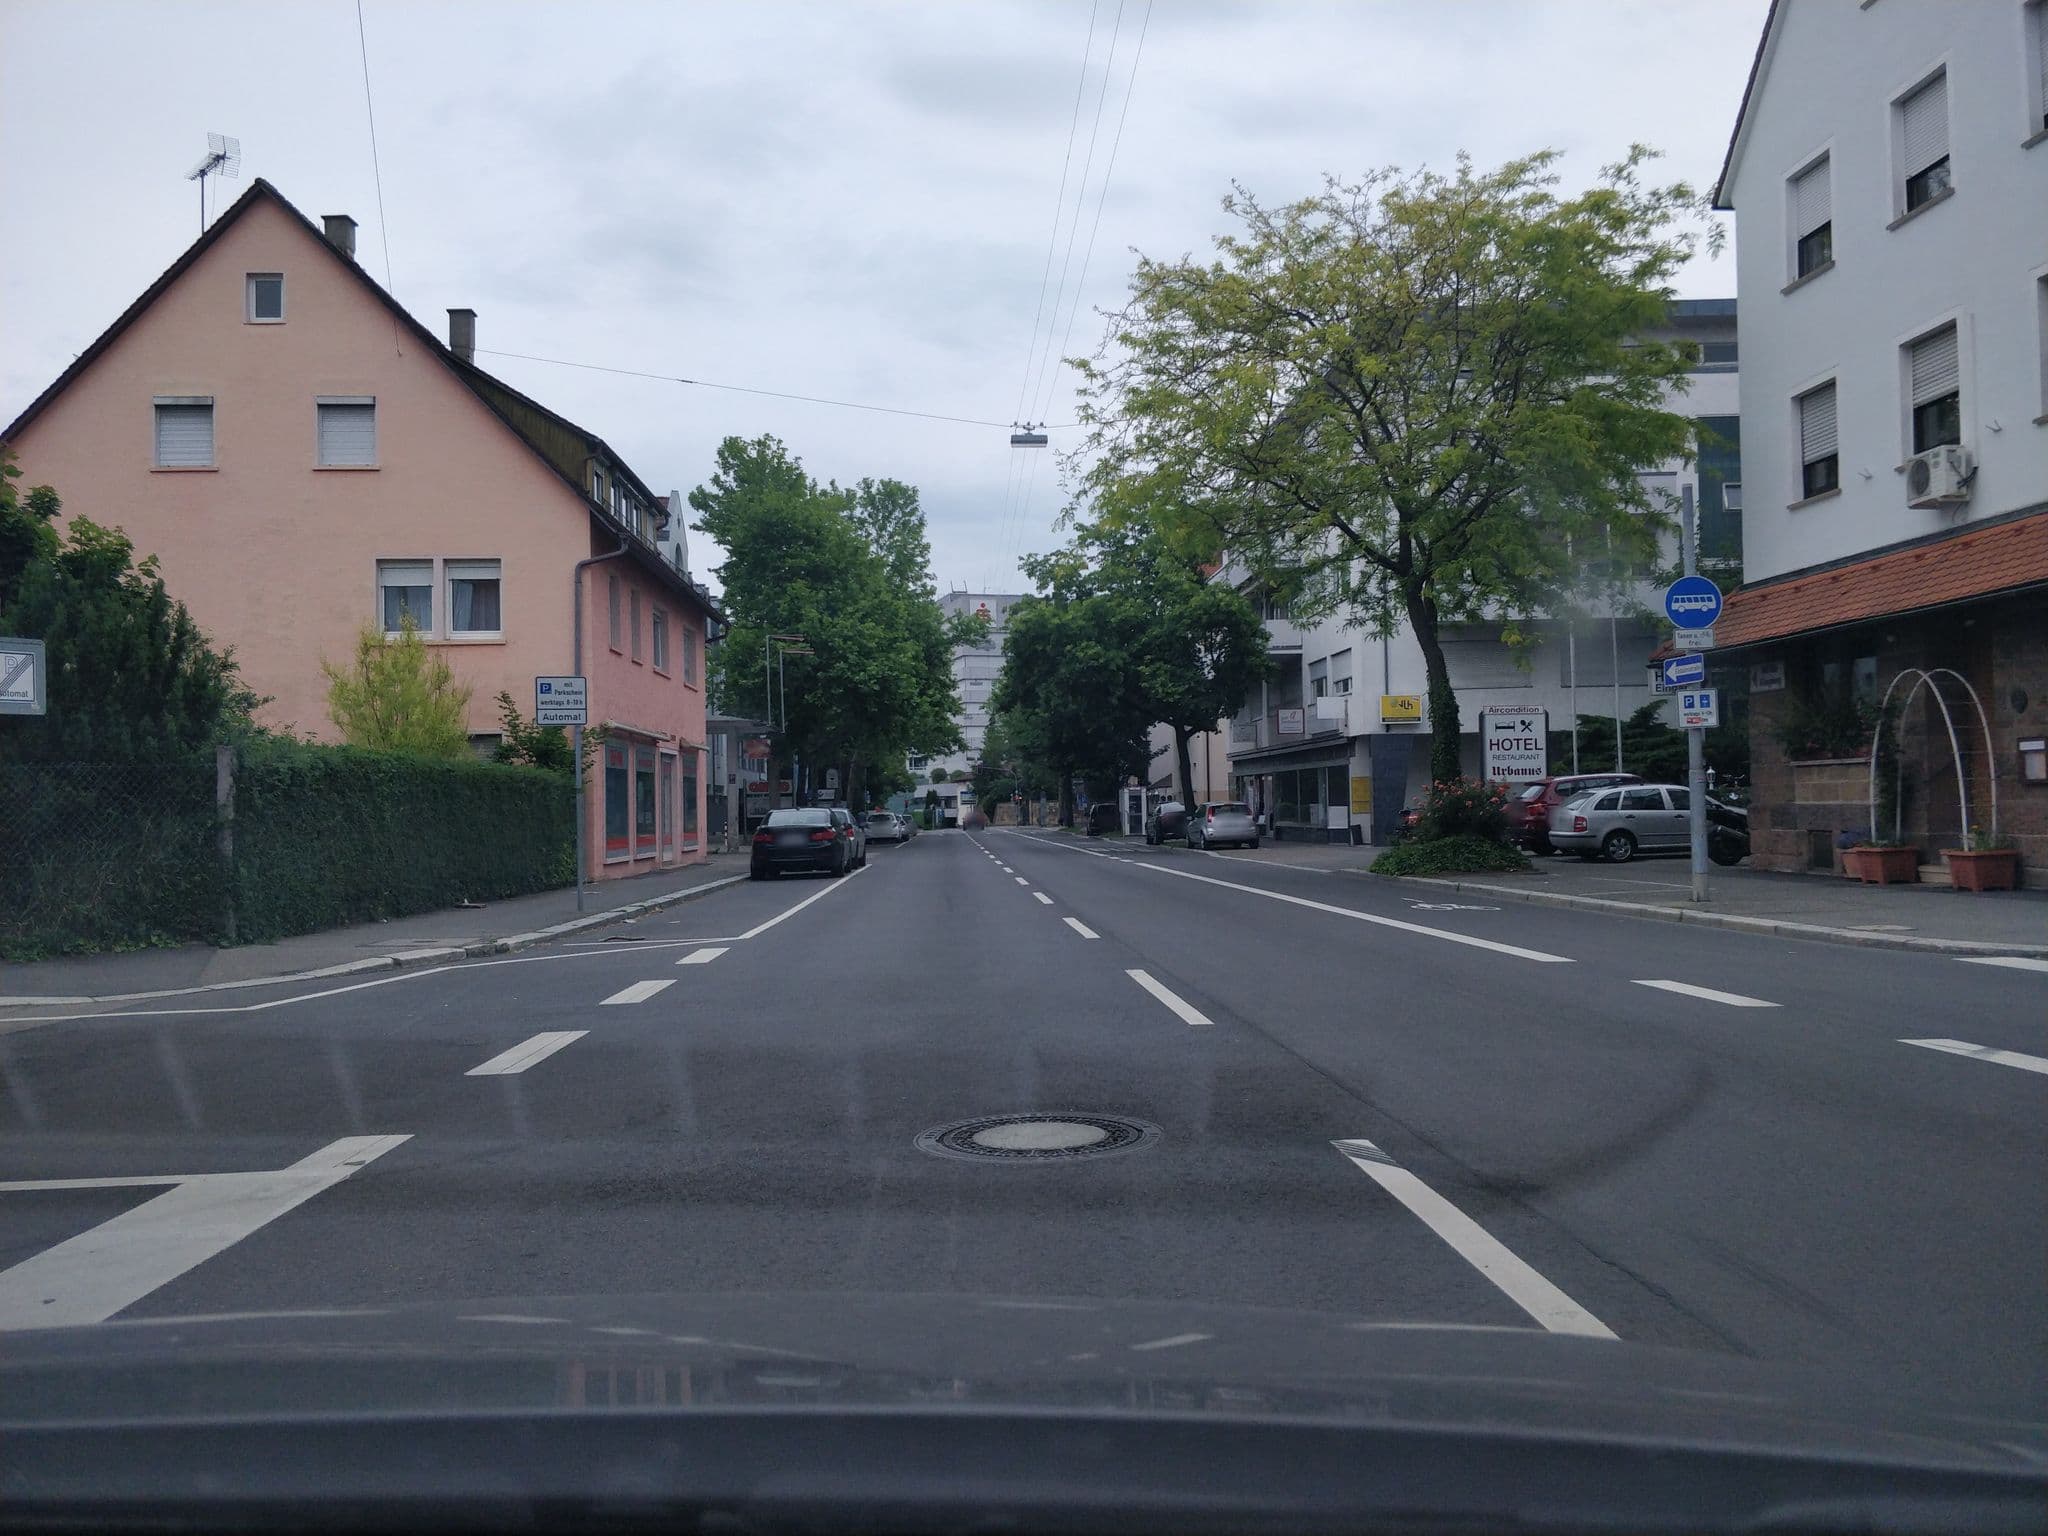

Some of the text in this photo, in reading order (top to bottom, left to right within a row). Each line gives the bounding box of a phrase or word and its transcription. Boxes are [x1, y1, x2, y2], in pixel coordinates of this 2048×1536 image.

[1488, 706, 1540, 714] Aircondition
[1490, 738, 1543, 751] HOTEL
[1492, 753, 1540, 761] RESTAURANT
[1492, 766, 1542, 776] Urbanus
